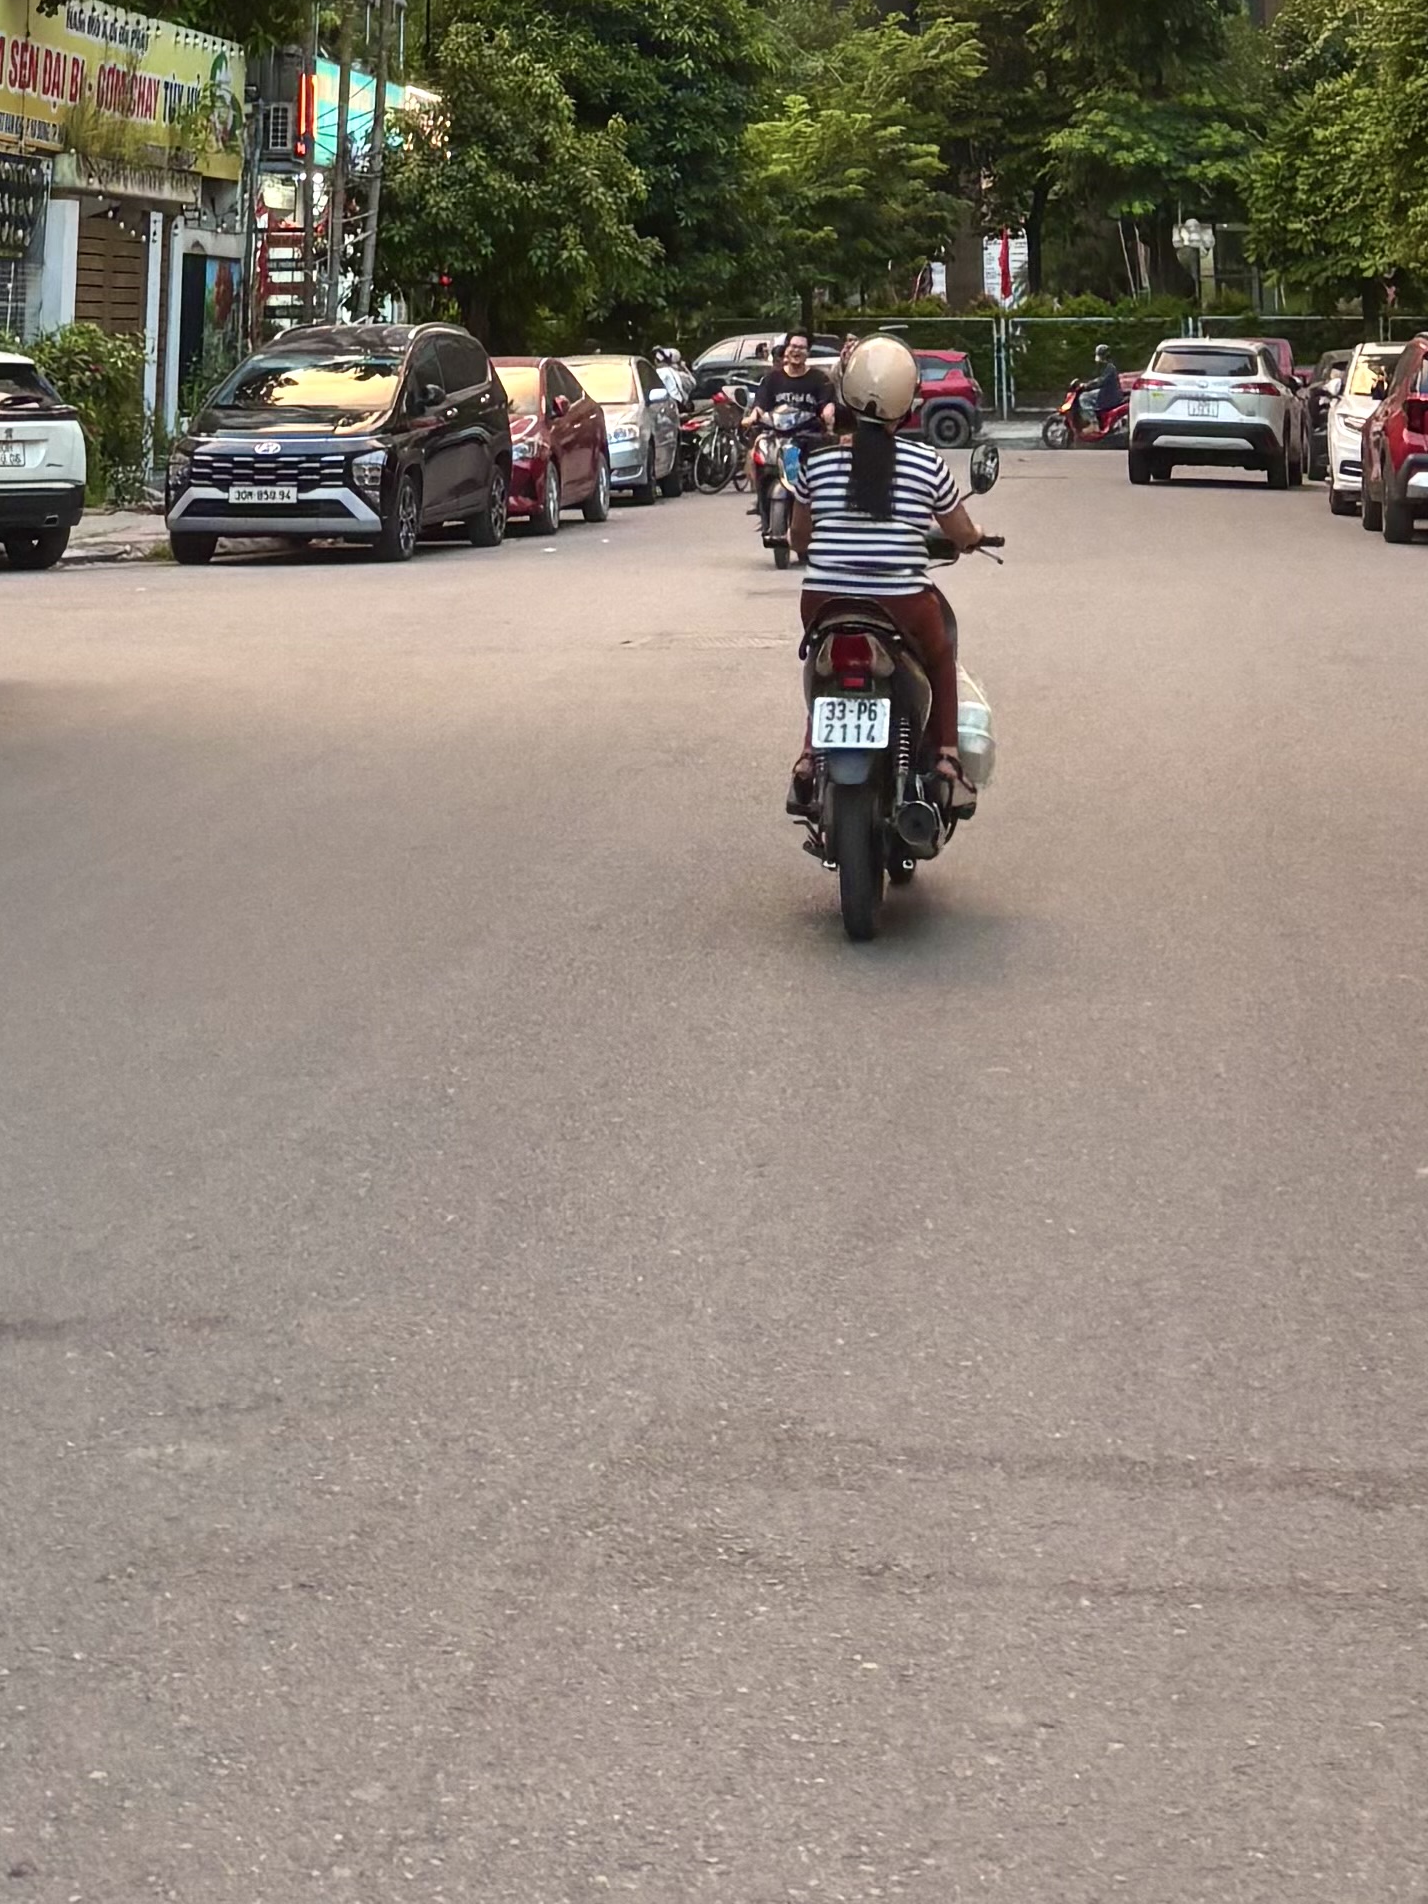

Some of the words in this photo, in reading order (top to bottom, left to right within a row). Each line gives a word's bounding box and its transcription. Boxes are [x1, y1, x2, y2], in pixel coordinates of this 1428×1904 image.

[8, 38, 39, 94] SEN
[42, 49, 67, 111] ĐẠI
[68, 54, 85, 104] BI
[130, 72, 161, 121] CHAY
[825, 701, 878, 722] 33-P6
[823, 723, 876, 743] 2114
